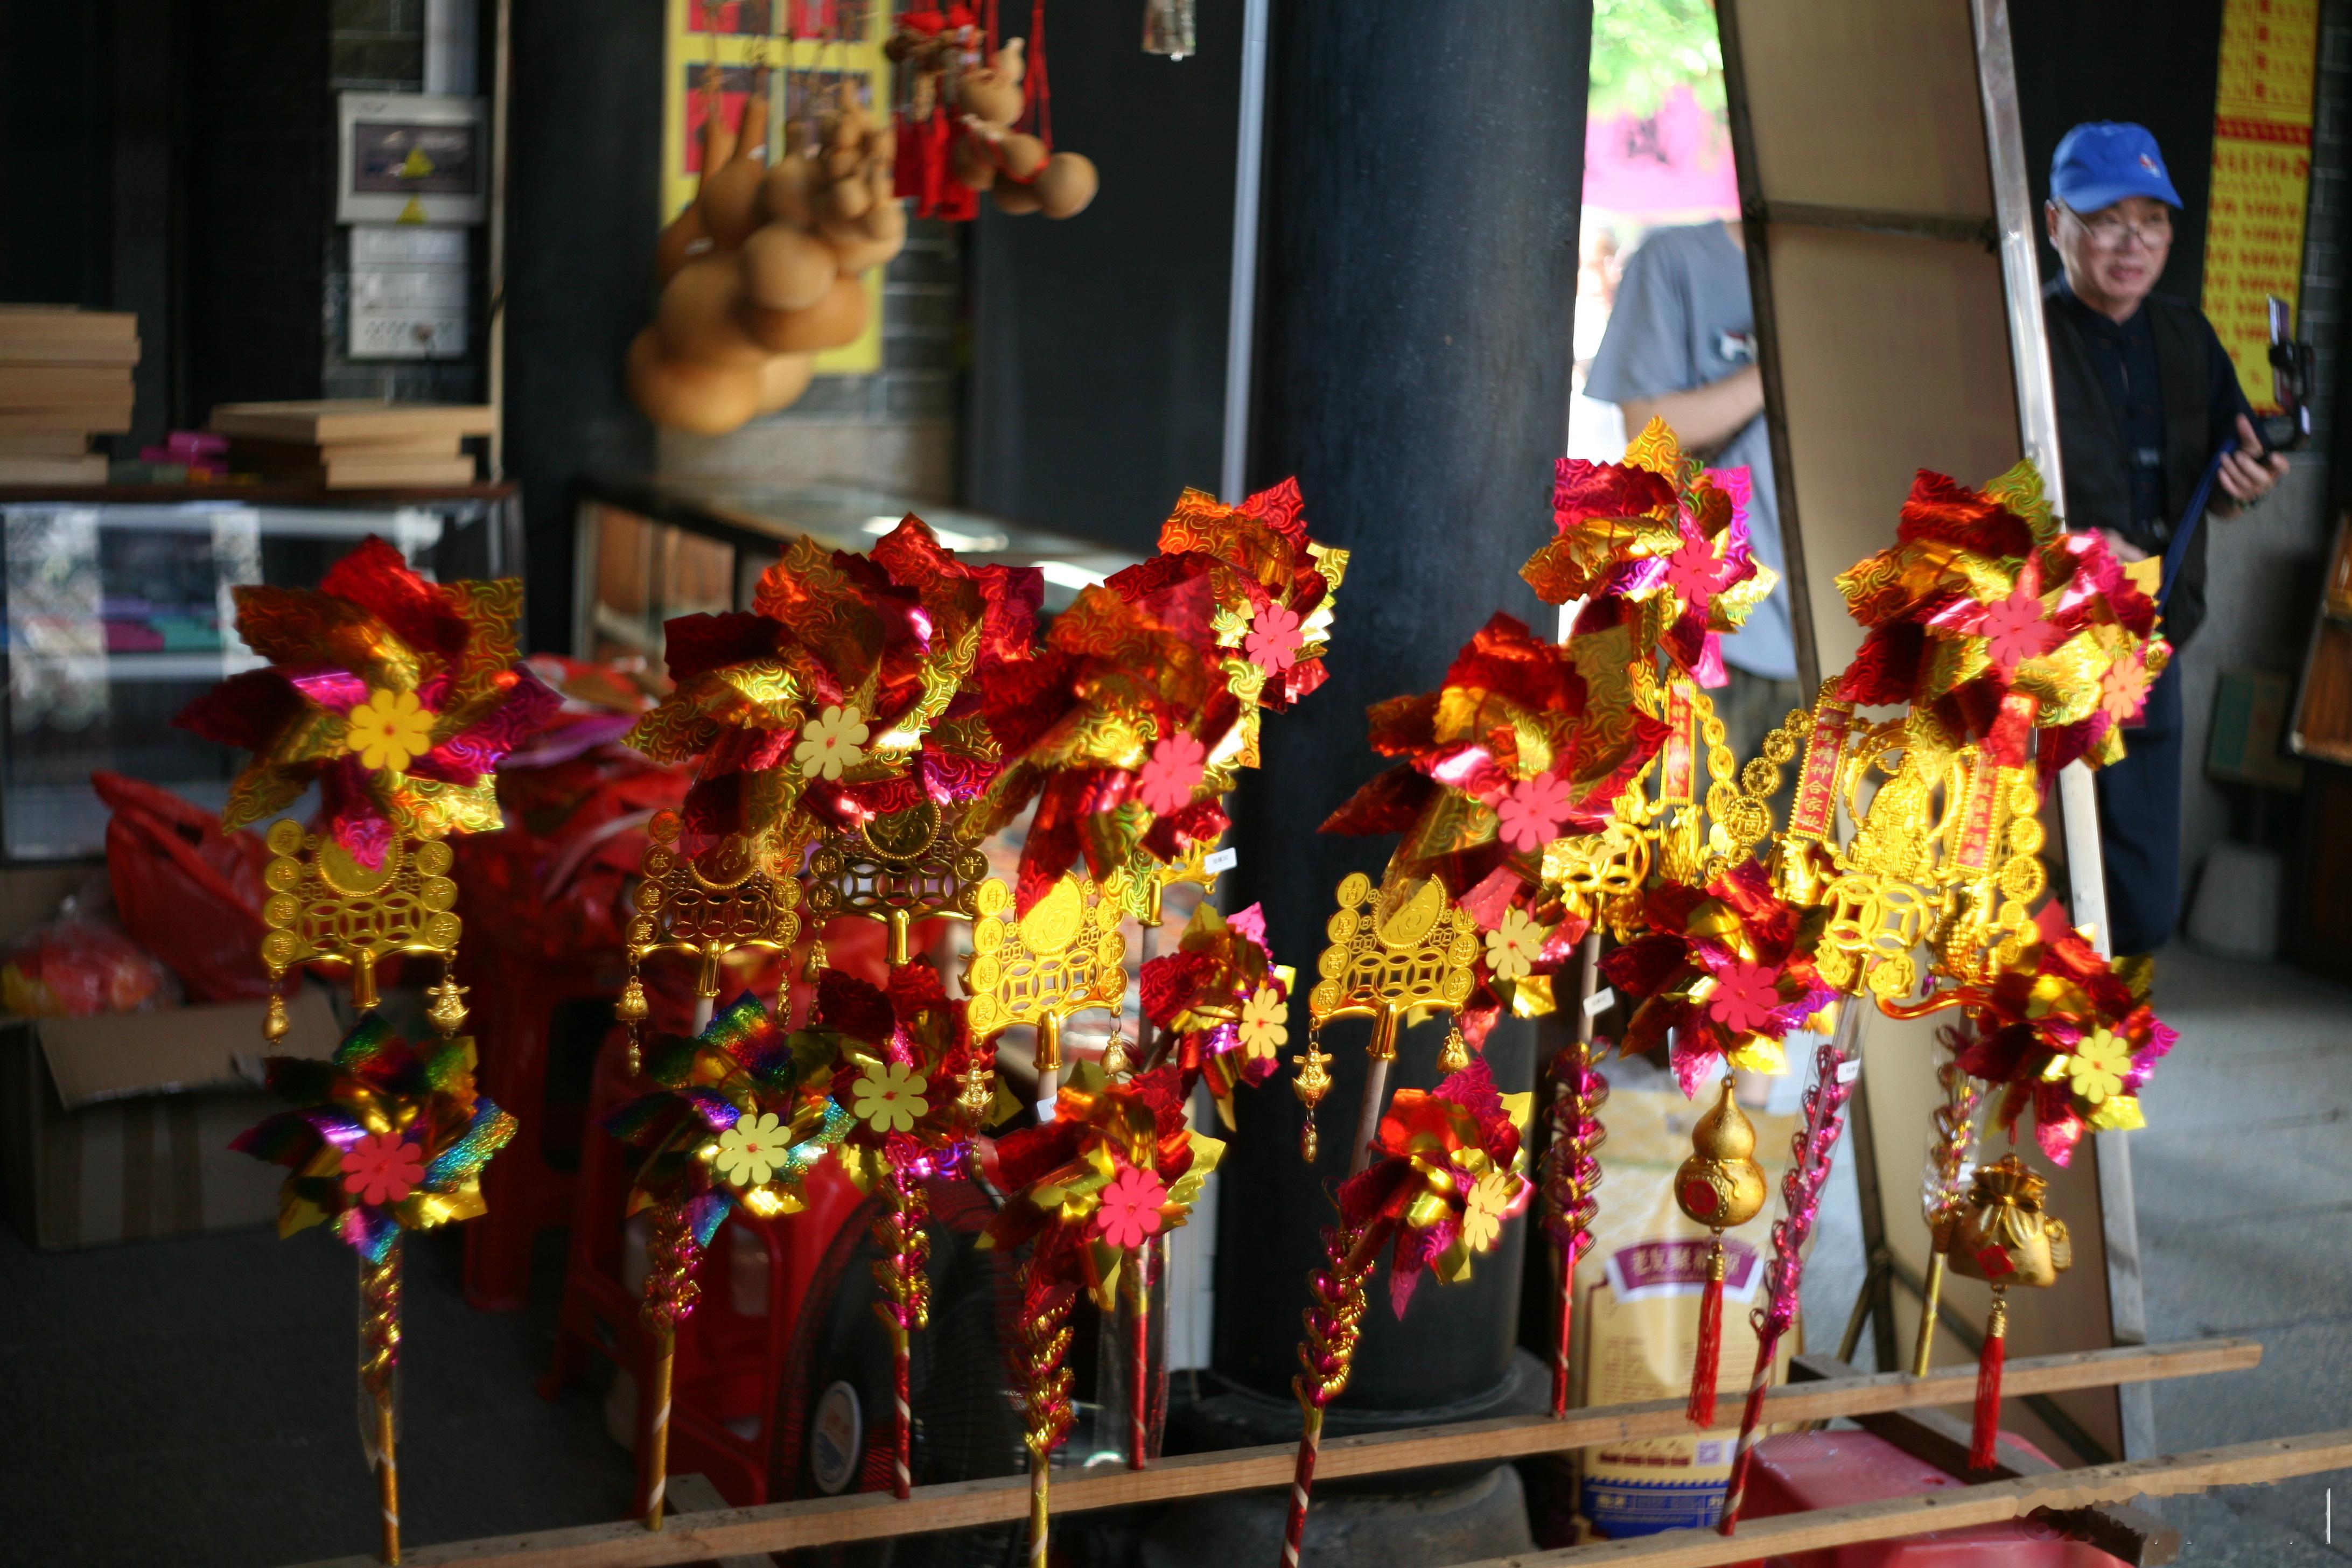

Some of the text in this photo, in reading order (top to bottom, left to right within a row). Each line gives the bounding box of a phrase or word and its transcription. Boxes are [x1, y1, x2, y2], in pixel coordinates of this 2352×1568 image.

[975, 888, 1000, 1022] 身体健康
[1318, 880, 1363, 1005] 吉星高照
